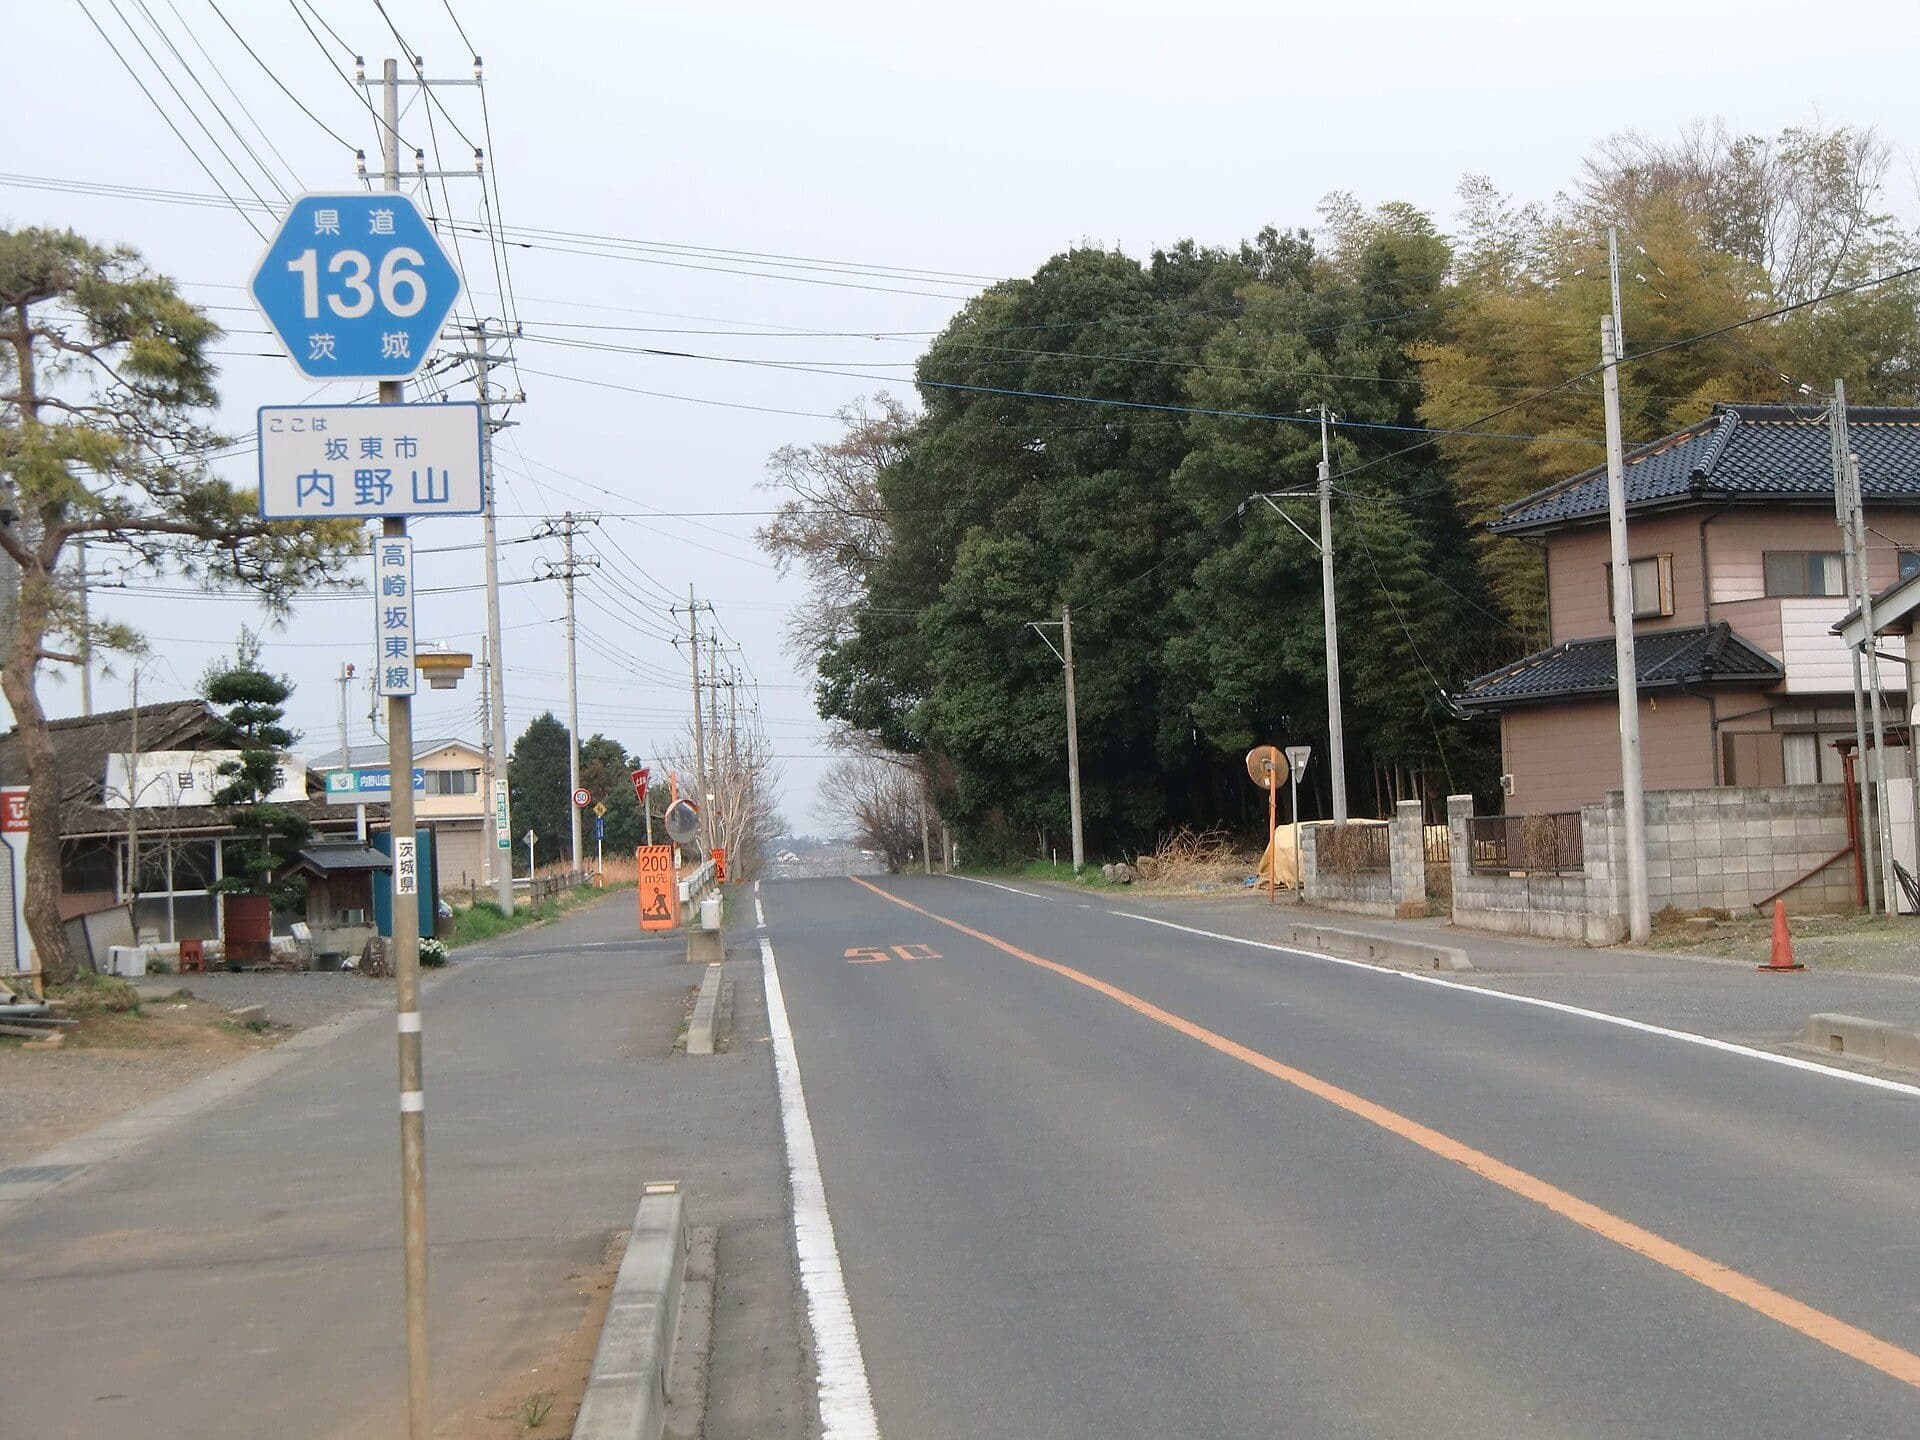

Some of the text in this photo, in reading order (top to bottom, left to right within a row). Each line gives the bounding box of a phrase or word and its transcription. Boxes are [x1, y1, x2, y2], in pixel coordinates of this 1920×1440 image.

[314, 209, 395, 235] 県道
[287, 247, 427, 319] 136
[308, 331, 411, 361] 茨城
[269, 416, 328, 434] ここは
[324, 435, 418, 461] 坂東市
[296, 466, 449, 507] 内野山
[382, 544, 410, 689] 高崎坂東線
[576, 793, 587, 802] 50
[399, 842, 415, 892] 茨城県
[641, 855, 668, 872] 200
[644, 873, 668, 884] m先
[843, 943, 944, 964] 50
